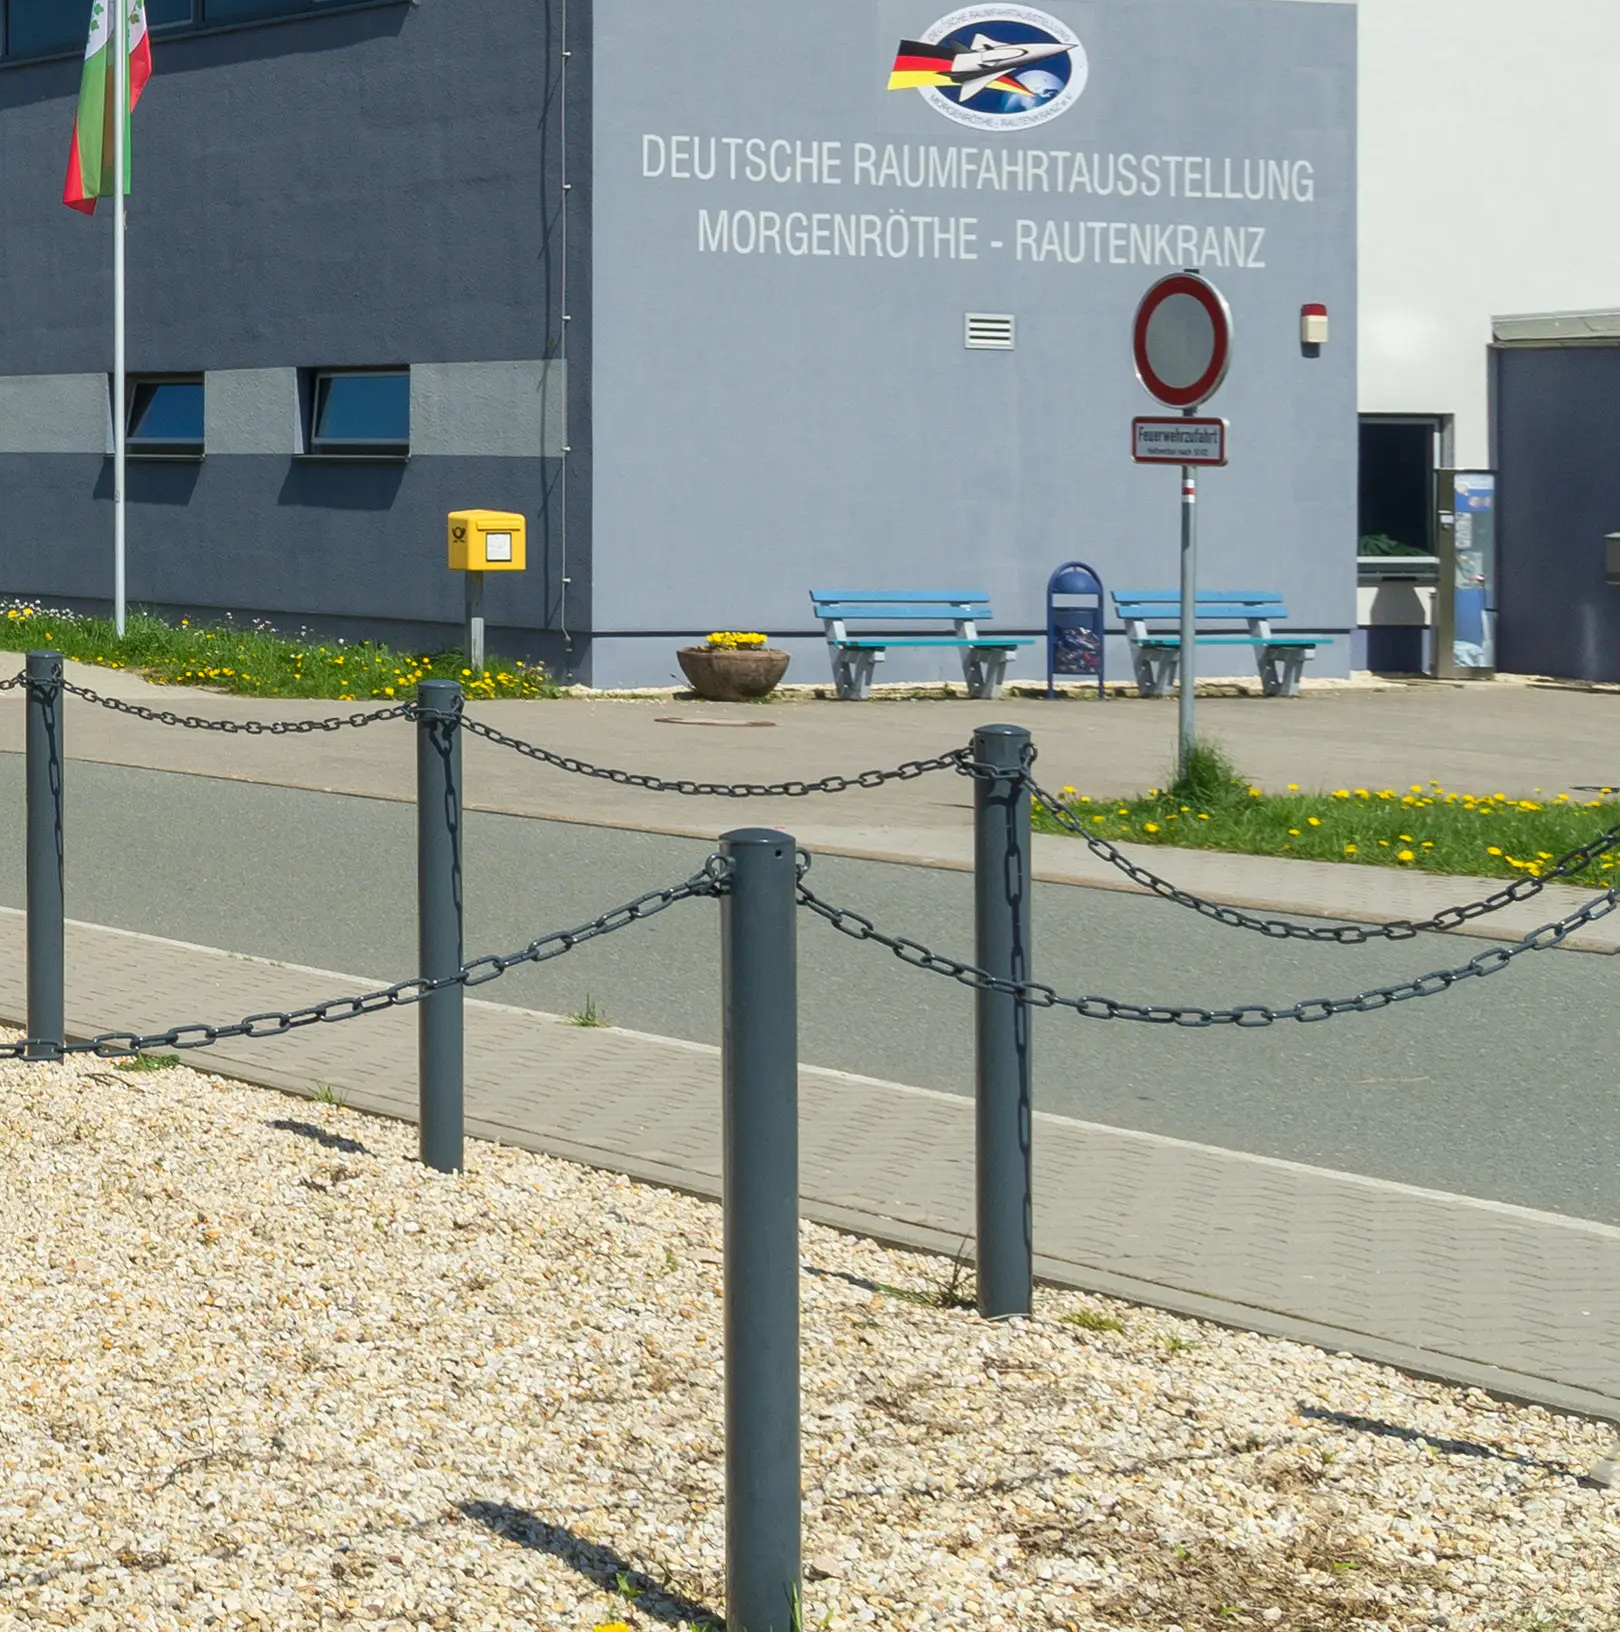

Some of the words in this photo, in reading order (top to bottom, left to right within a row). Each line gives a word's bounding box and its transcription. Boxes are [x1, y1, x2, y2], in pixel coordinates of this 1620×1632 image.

[641, 134, 842, 185] DEUTSCHE
[853, 142, 1315, 202] RAUMFAHRTAUSSTELLUNG
[698, 208, 978, 260] MORGENRÖTHE
[990, 240, 1004, 248] -
[1016, 218, 1267, 269] RAUTENKRANZ
